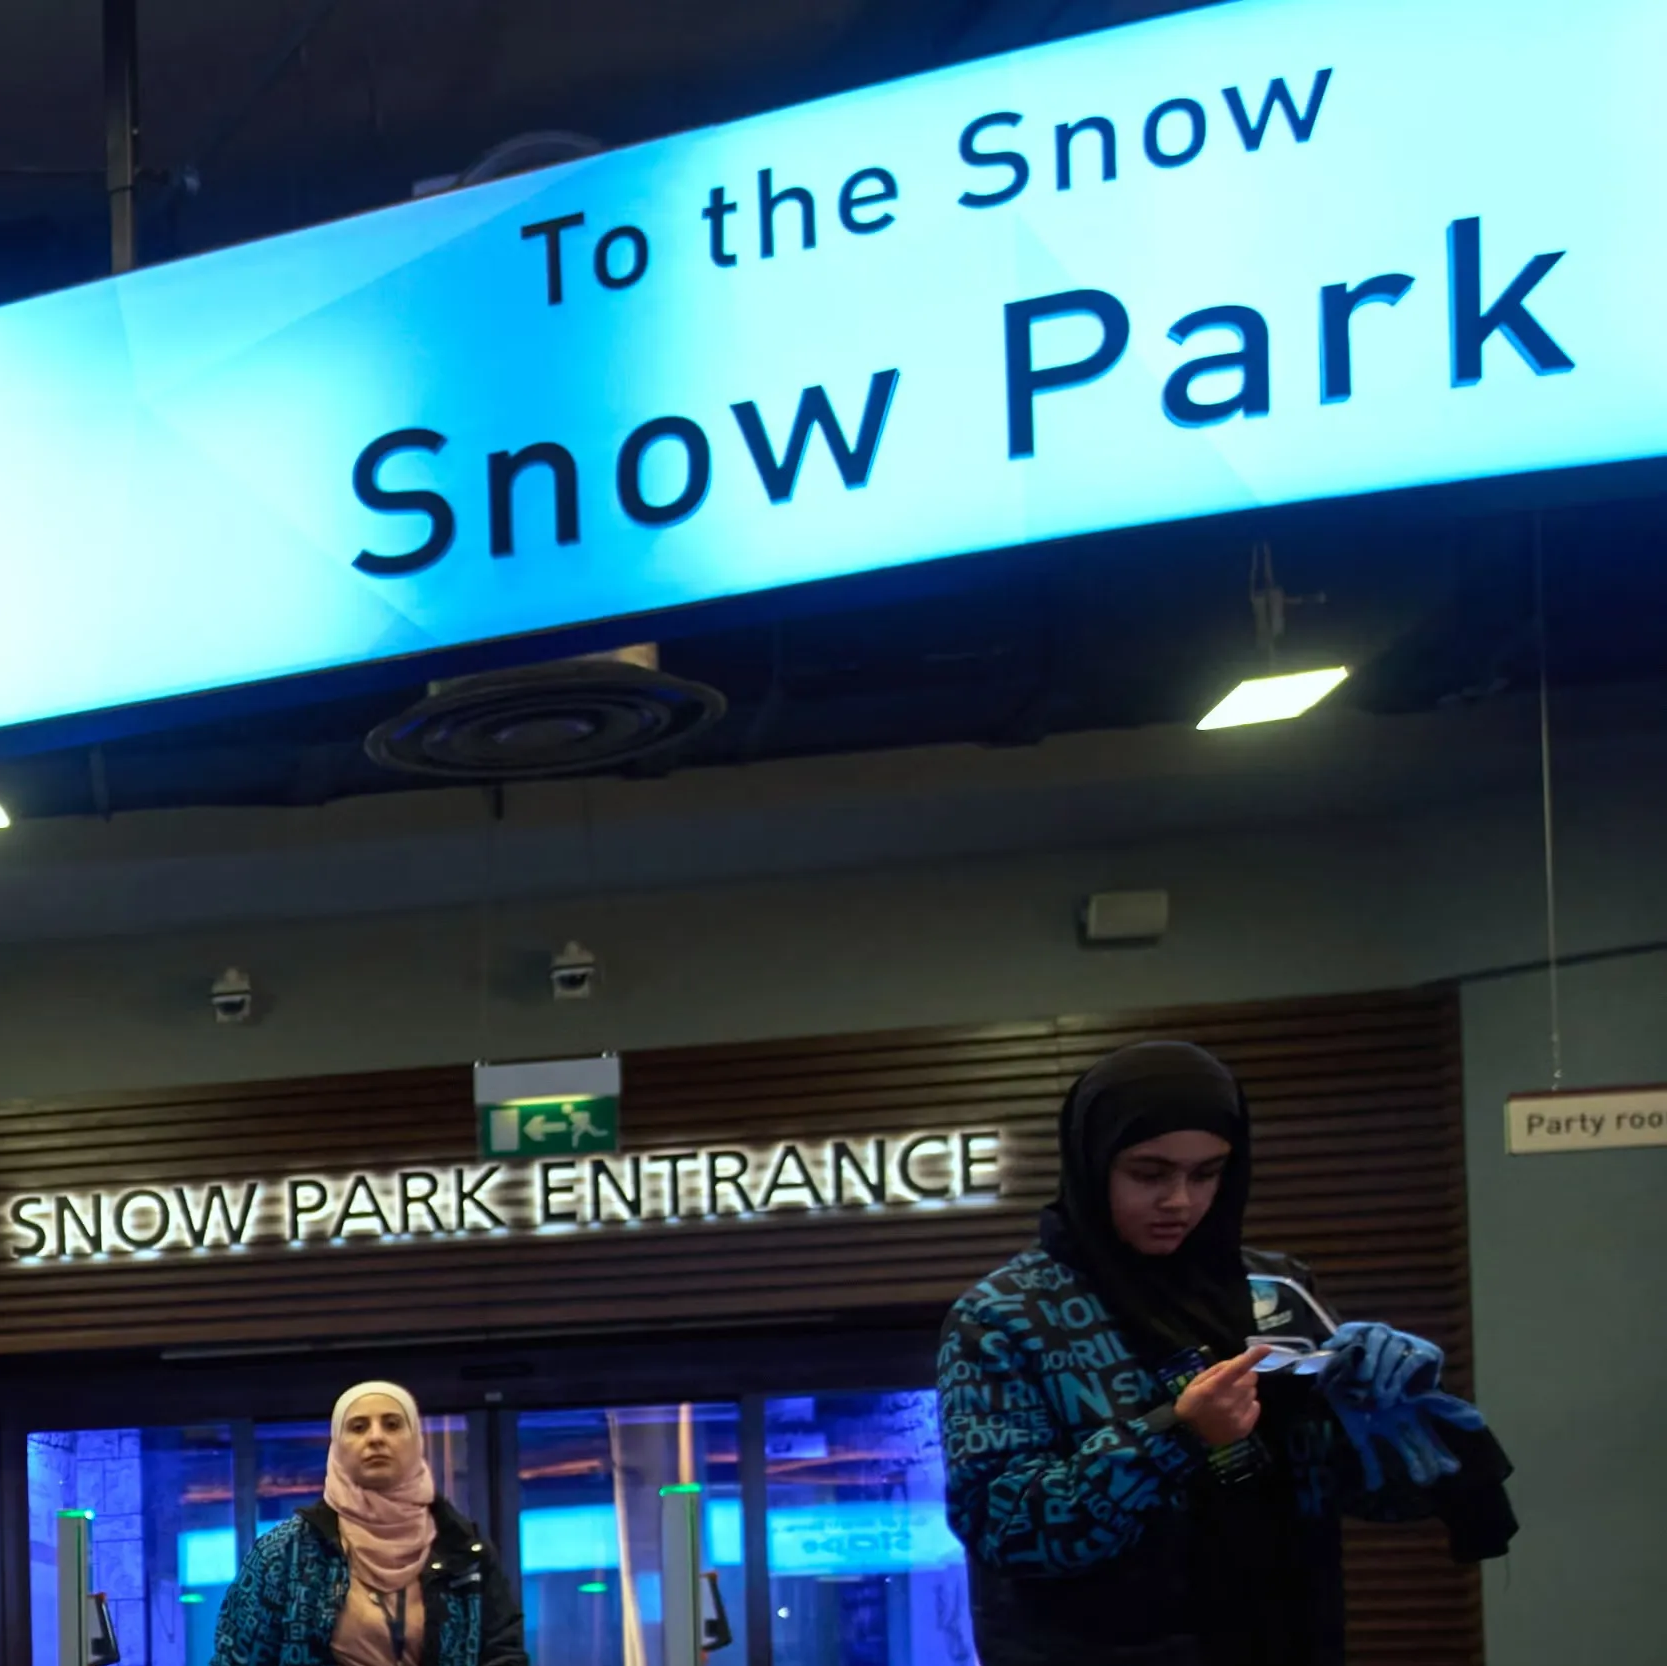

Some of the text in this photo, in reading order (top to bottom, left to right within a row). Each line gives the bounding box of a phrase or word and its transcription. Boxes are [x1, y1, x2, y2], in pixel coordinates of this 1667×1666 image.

[521, 67, 1334, 306] To the Snow
[351, 215, 1576, 579] Snow Park
[10, 1129, 1002, 1259] SNOW PARK ENTRANCE
[1526, 1110, 1667, 1137] Party roo
